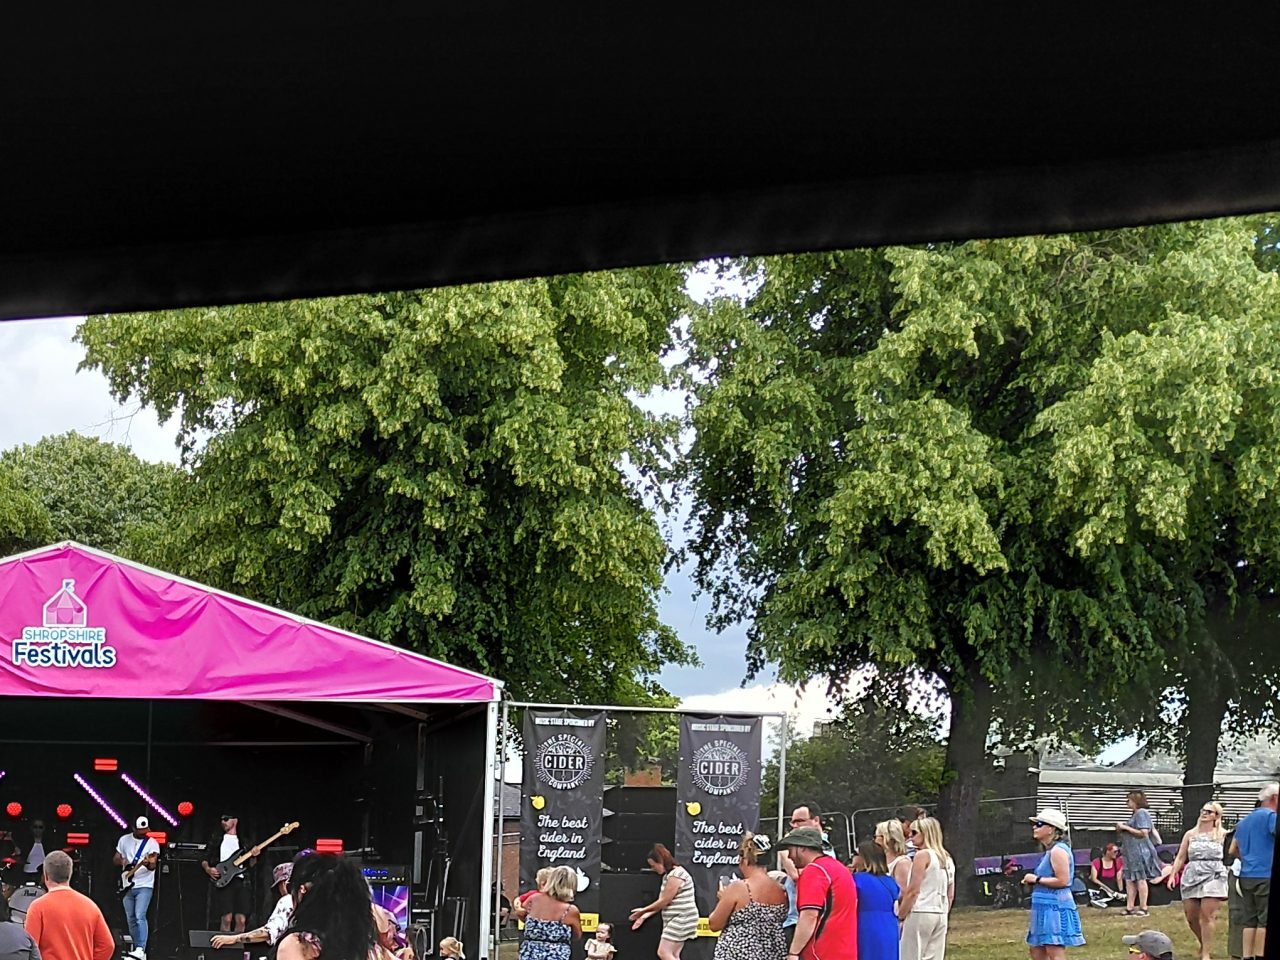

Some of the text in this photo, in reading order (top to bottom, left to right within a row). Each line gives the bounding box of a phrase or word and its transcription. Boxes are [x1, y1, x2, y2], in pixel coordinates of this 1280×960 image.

[24, 629, 104, 641] SHROPSHIRE
[14, 641, 114, 665] Festivals
[543, 734, 586, 749] THE SPECIAL
[700, 740, 742, 756] THE SPECIAL
[544, 756, 583, 769] CIDER
[700, 762, 739, 775] CIDER
[548, 779, 580, 790] COMPANY
[704, 785, 736, 796] COMPANY
[537, 814, 588, 828] The best
[692, 820, 744, 834] The best
[539, 830, 584, 843] cider in
[694, 836, 739, 849] cider in
[537, 844, 586, 862] England
[692, 850, 740, 868] England
